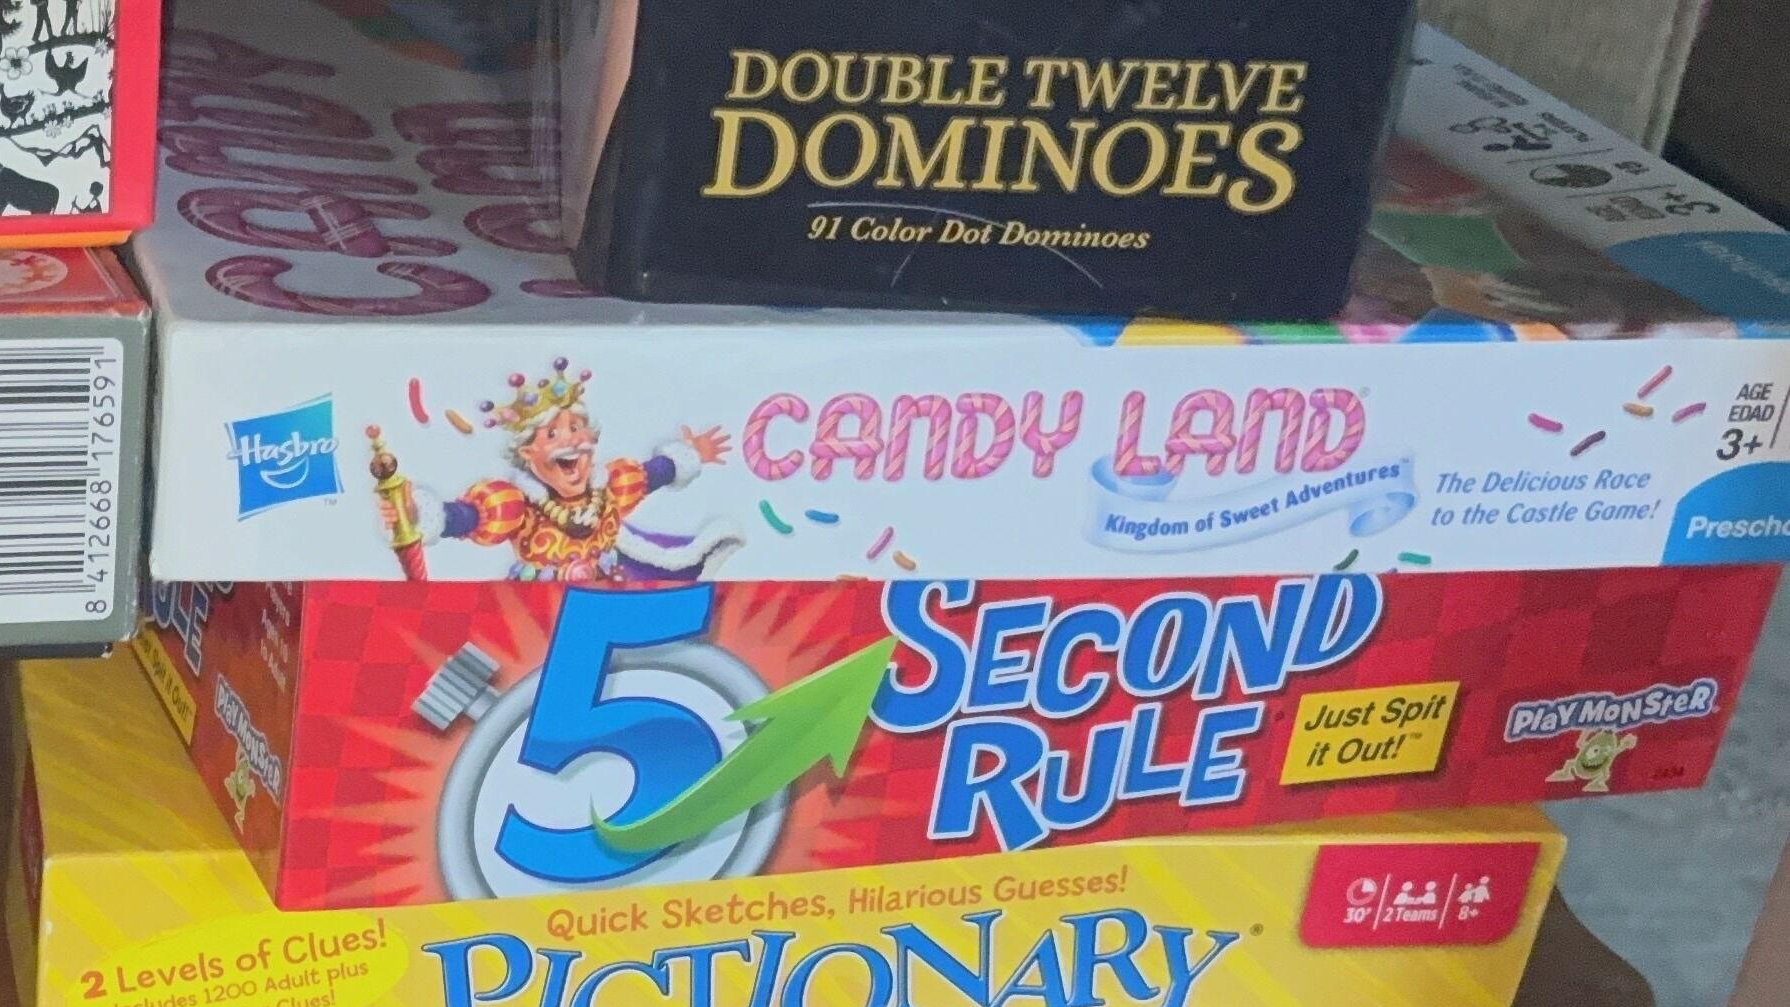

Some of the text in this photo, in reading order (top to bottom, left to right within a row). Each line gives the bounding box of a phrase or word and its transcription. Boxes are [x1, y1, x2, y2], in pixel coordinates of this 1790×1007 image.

[727, 49, 1308, 114] DOUBLE TWELVE
[701, 106, 1304, 216] DOMINOES
[807, 215, 1150, 250] 91 Color Dot Dominoes
[1736, 382, 1773, 401] AGE
[1728, 404, 1775, 422] EDAD
[227, 432, 338, 468] Hasbro
[741, 387, 1367, 482] CANDY LAND
[1716, 428, 1763, 460] 3+
[1436, 469, 1651, 494] The Delicious Race
[1103, 462, 1402, 542] Kingdom of Sweet Adventures
[1431, 500, 1662, 527] to the Castle Game!
[494, 576, 1384, 884] 5 SECOND
[1305, 694, 1447, 732] Just Spit
[1307, 734, 1406, 767] it Out!
[928, 701, 1265, 852] RULE
[547, 866, 1129, 939] Quick Sketches, Hilarious Guesses!
[1383, 907, 1394, 922] 2
[1396, 907, 1437, 921] Teams
[1458, 906, 1478, 920] 8+
[81, 918, 388, 999] 2 Levels of Clues!
[204, 980, 258, 1003] 1200
[264, 969, 321, 993] Adult
[327, 960, 369, 987] plus
